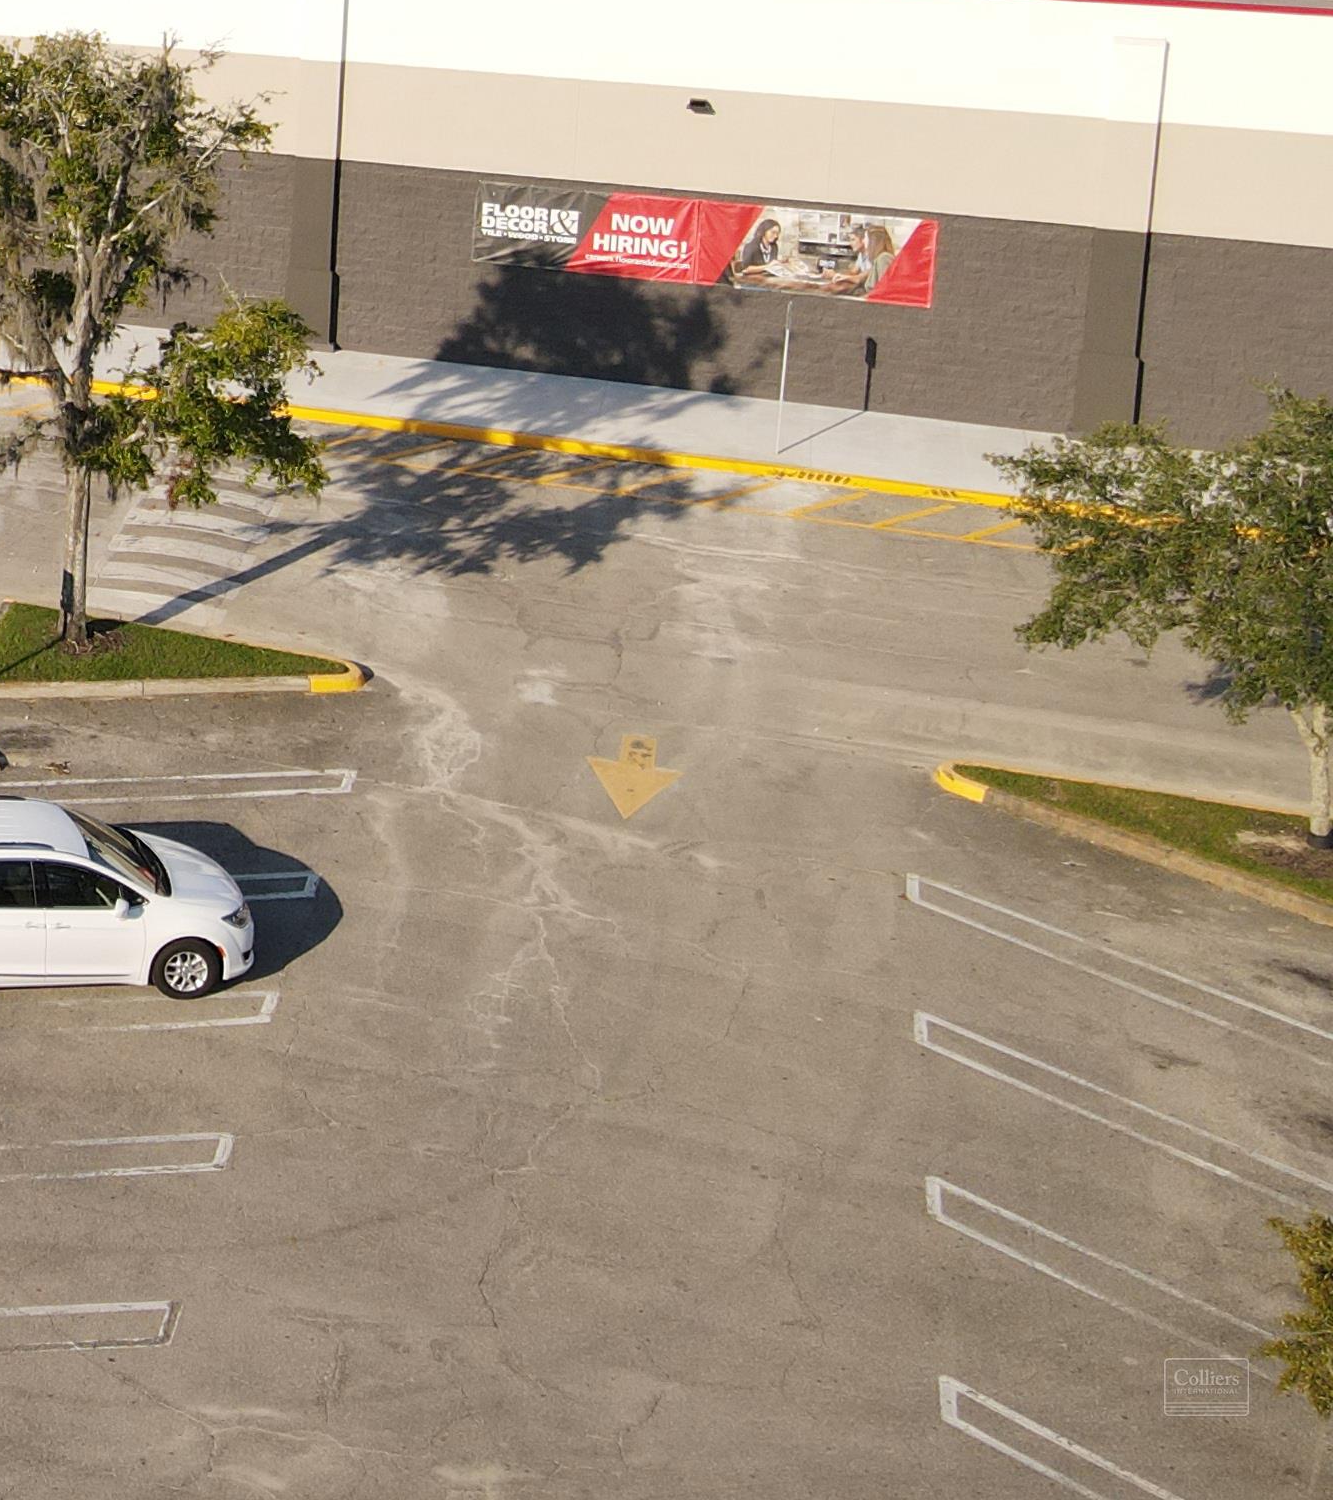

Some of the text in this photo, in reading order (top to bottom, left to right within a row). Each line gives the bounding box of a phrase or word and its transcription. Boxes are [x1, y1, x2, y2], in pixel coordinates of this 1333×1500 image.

[481, 215, 548, 234] DECOR
[482, 202, 580, 235] FLOOR &
[611, 213, 674, 236] NOW
[593, 233, 687, 259] HIRING!
